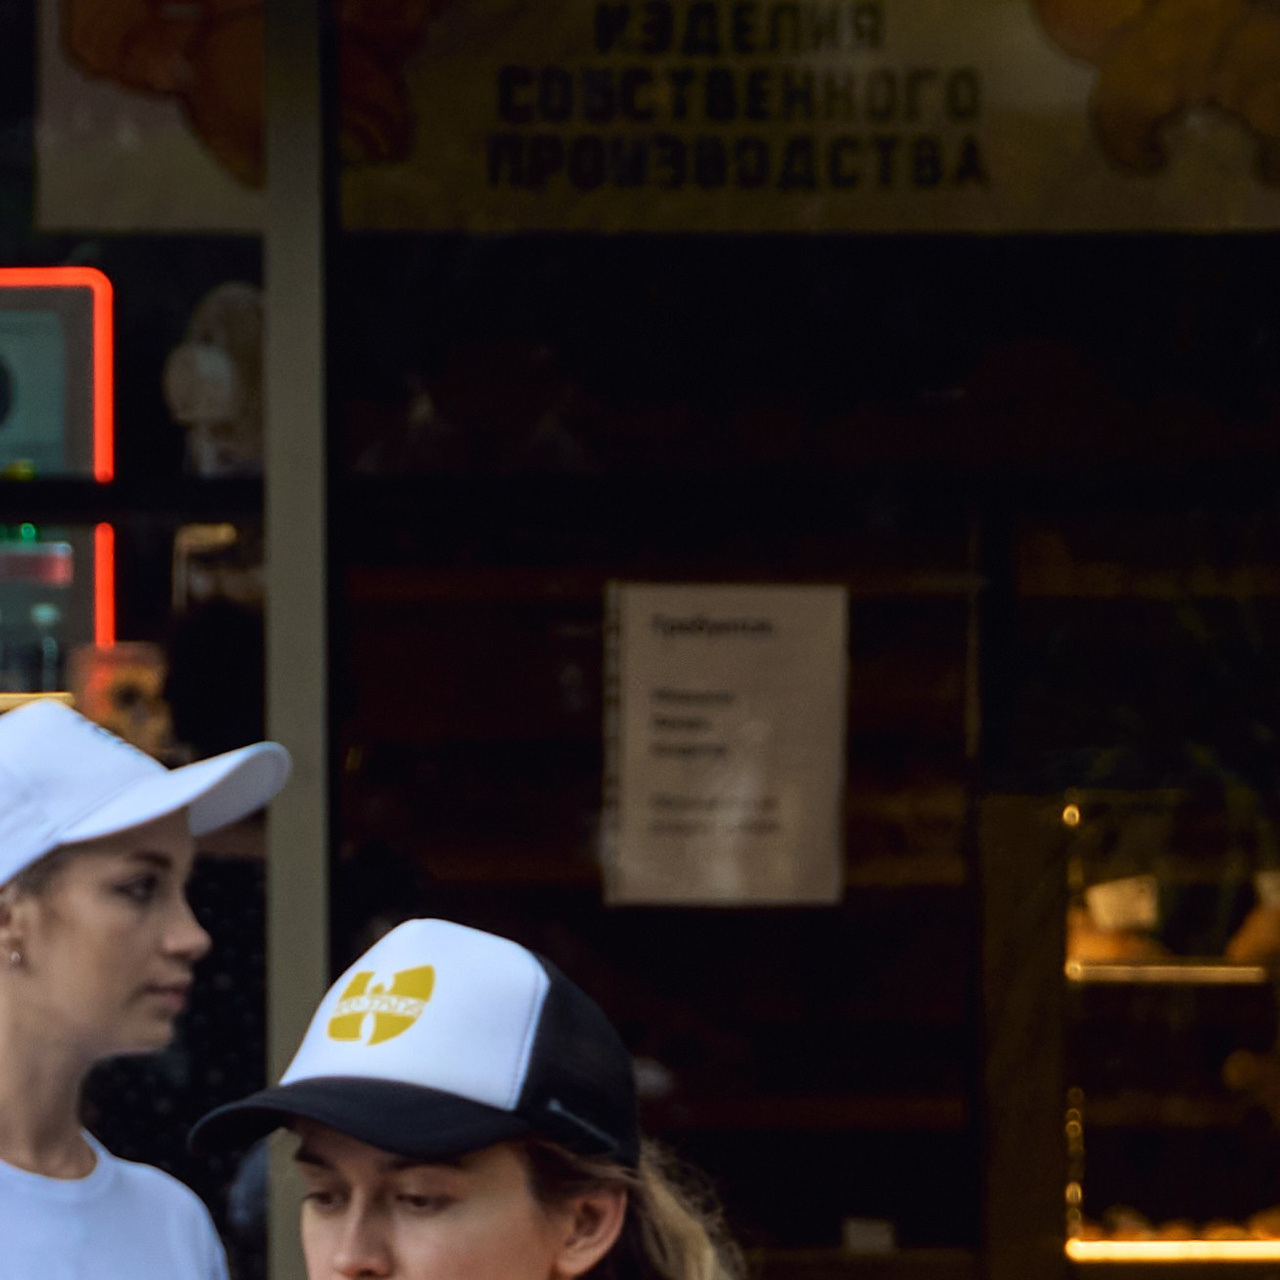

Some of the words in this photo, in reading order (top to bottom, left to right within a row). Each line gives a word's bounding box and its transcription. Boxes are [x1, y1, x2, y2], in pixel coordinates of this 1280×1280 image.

[593, 0, 884, 55] ИЗДЕЛИЯ
[497, 64, 982, 124] СОБСТВЕННОГО
[487, 133, 990, 191] ПРОИЗВОДСТВА
